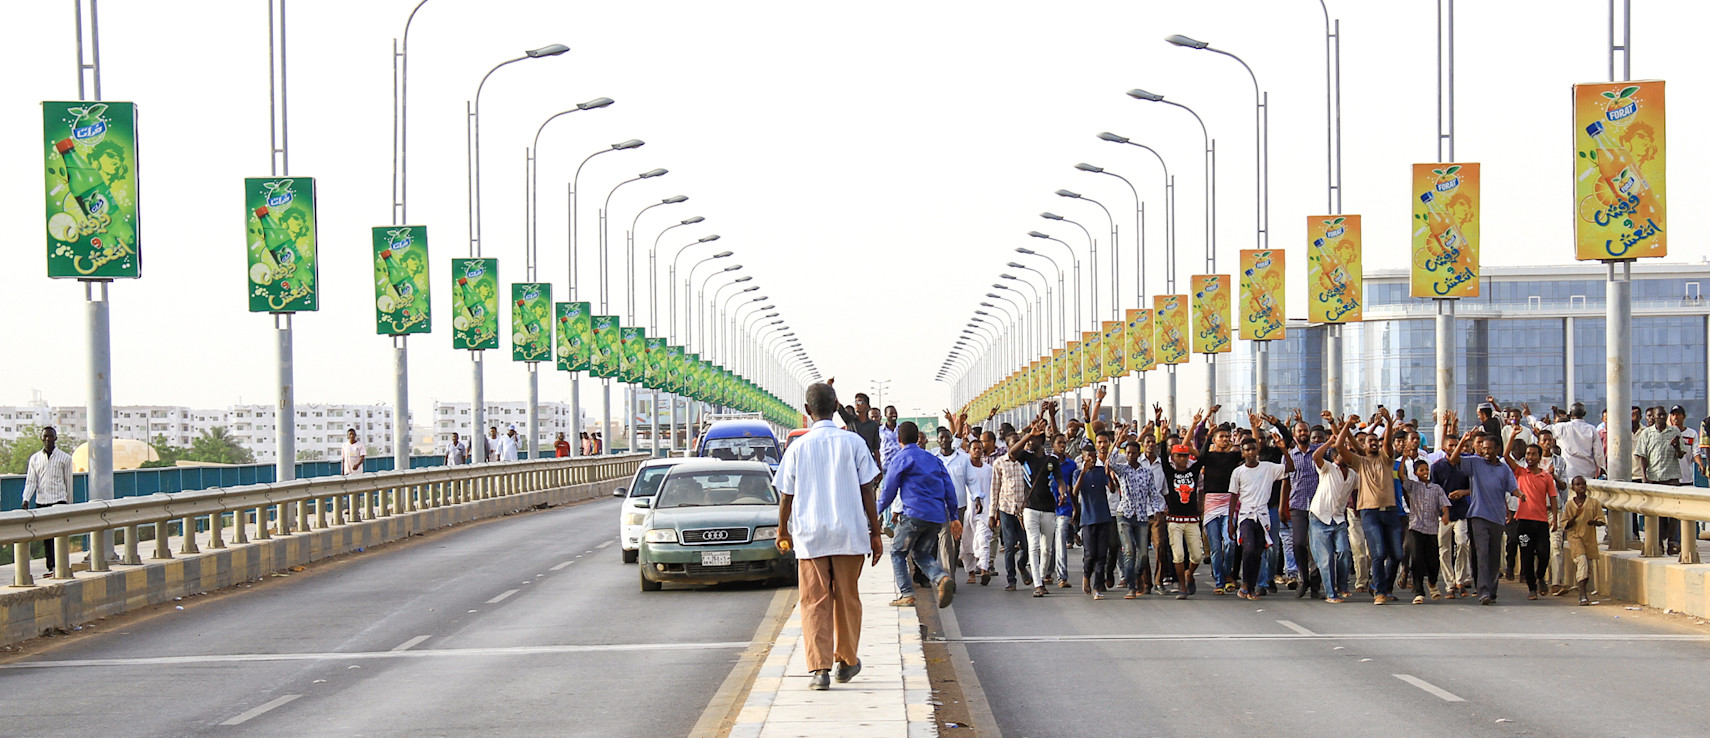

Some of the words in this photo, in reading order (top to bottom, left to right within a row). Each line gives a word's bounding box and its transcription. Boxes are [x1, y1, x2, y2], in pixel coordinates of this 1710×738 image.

[1609, 103, 1634, 120] FORAT
[77, 123, 103, 138] فرات
[1438, 179, 1456, 191] FORAT
[1594, 191, 1640, 226] فرفش
[1623, 218, 1634, 229] و
[91, 237, 102, 249] و
[1605, 218, 1663, 256] انتعش
[73, 236, 136, 275] انتعش
[1433, 266, 1476, 295] انتعش
